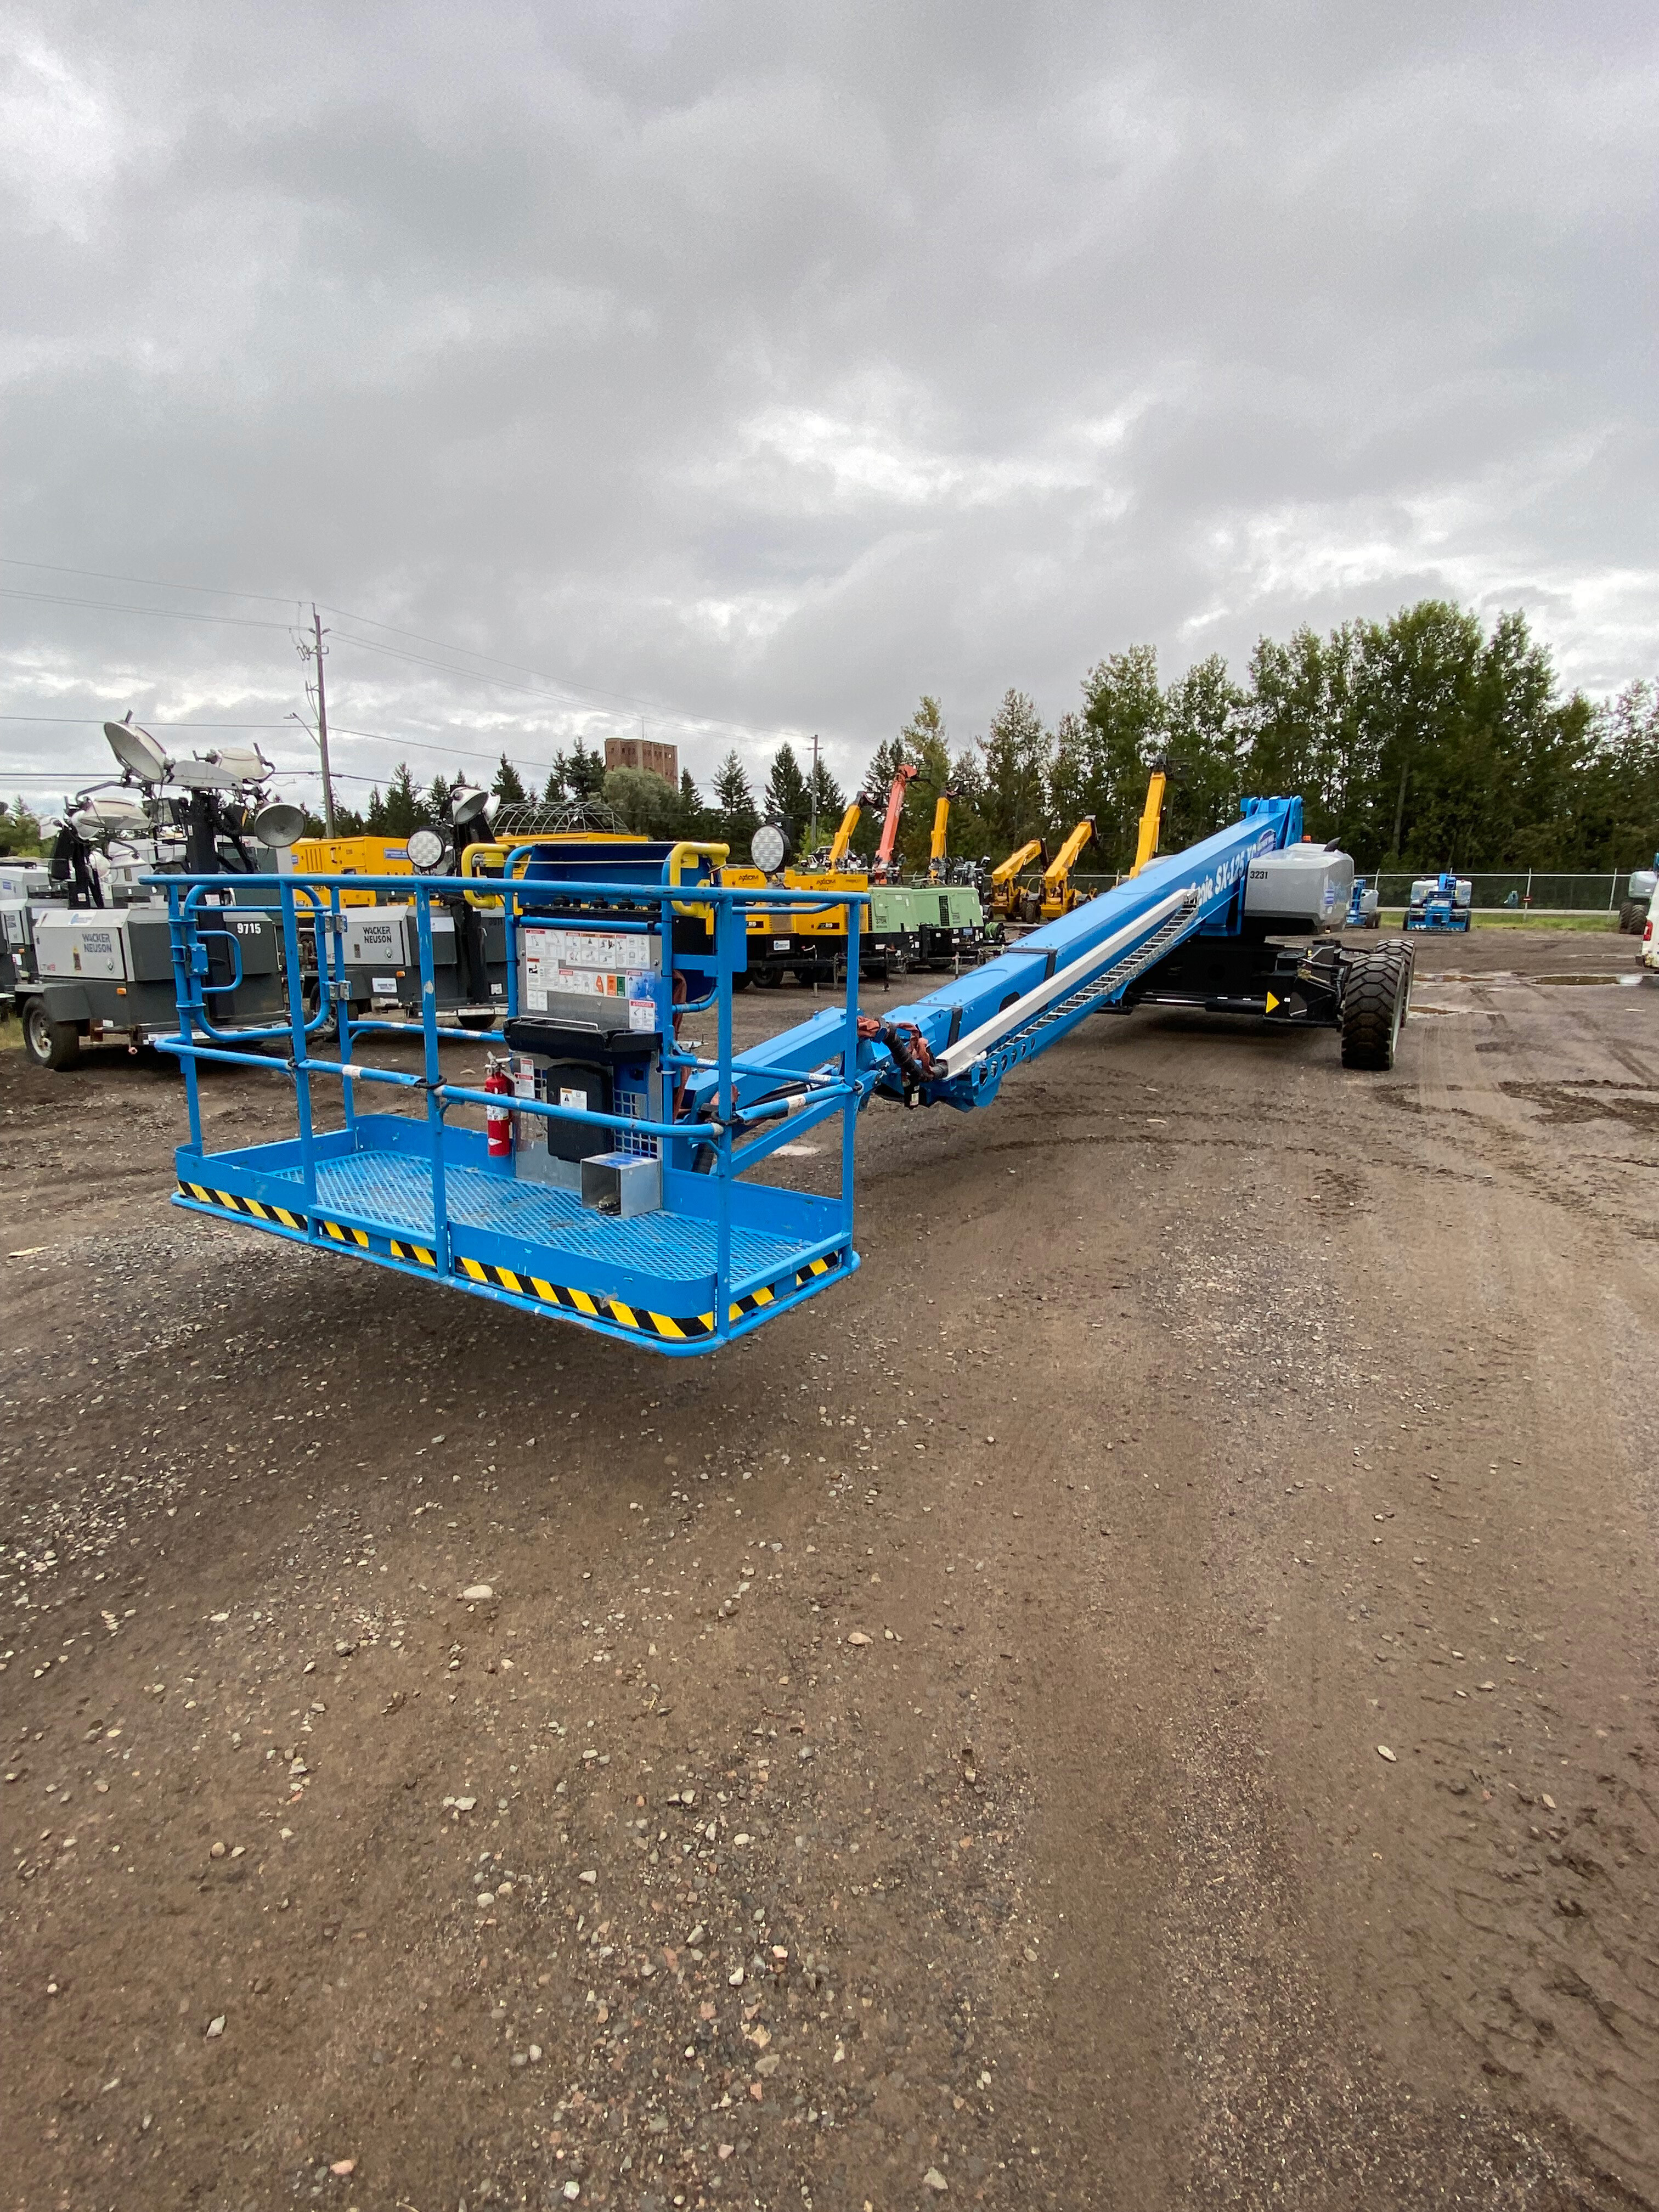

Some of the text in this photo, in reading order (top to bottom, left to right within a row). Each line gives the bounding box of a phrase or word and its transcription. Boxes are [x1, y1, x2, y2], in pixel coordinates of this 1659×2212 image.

[1215, 850, 1245, 895] SX-125
[1250, 871, 1268, 880] 3231
[236, 923, 261, 934] 9715
[363, 926, 391, 935] WACKER
[82, 933, 111, 943] WACKER
[364, 935, 392, 944] NEUSON
[84, 943, 112, 953] NEUSON
